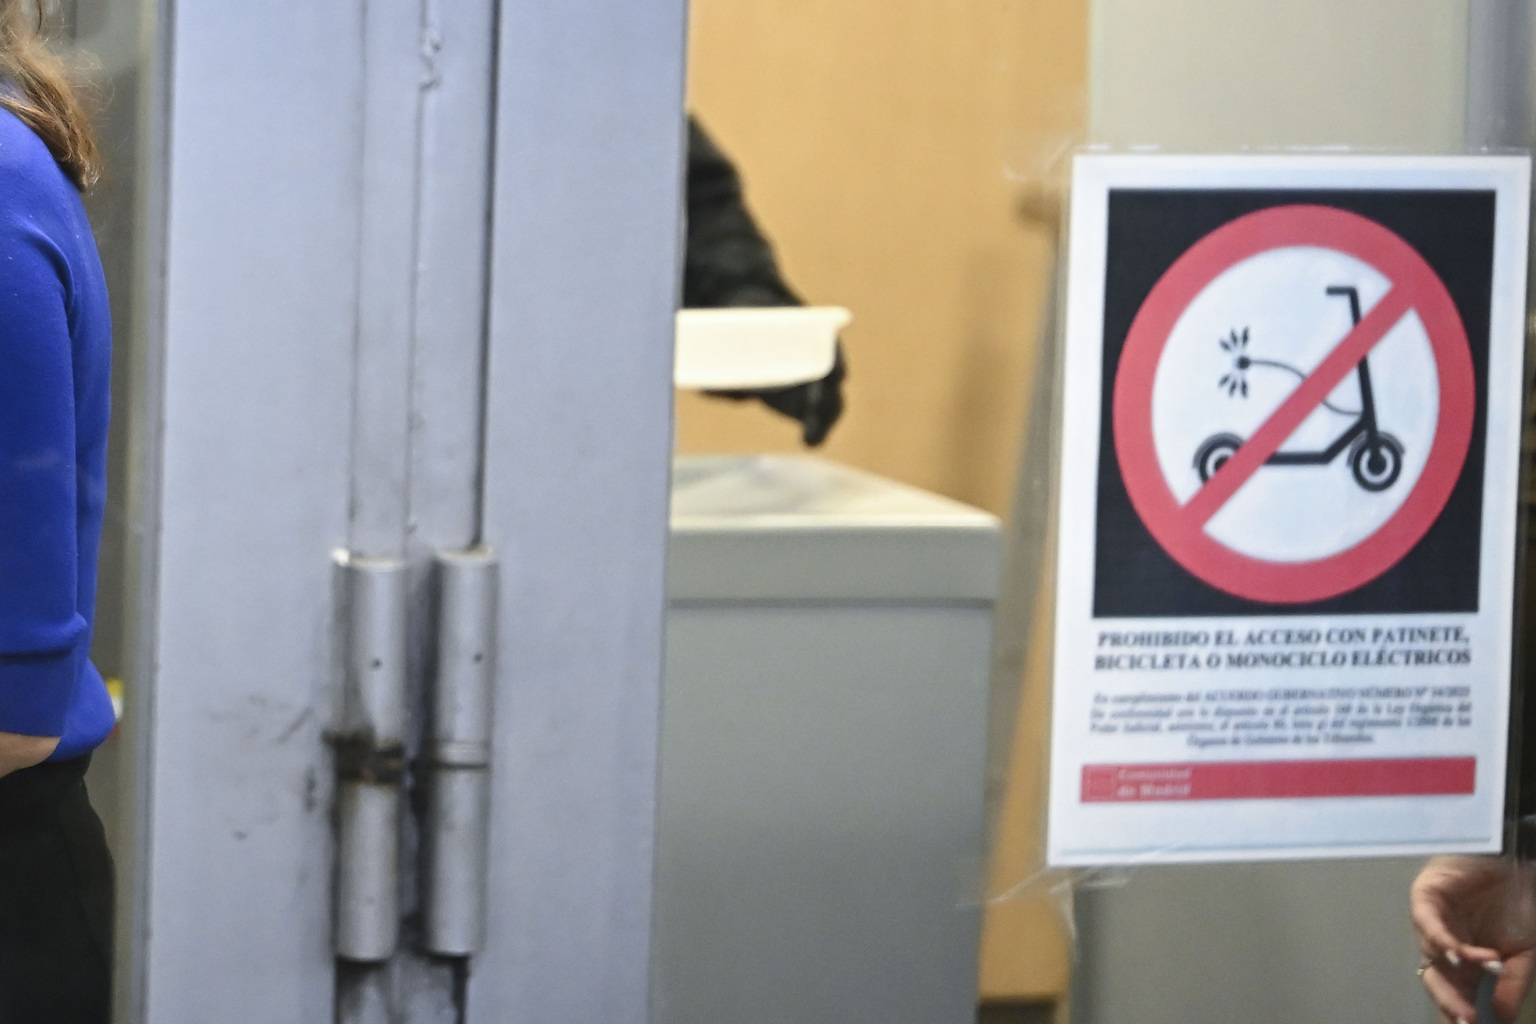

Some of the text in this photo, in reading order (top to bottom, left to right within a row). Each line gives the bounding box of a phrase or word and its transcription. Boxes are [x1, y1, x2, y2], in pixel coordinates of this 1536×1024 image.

[1097, 626, 1470, 647] PROHIBIDO EL ACCESO CON PATINETE,
[1094, 647, 1472, 670] BICICLETA O MONOCICLO ELÉCTRICOS
